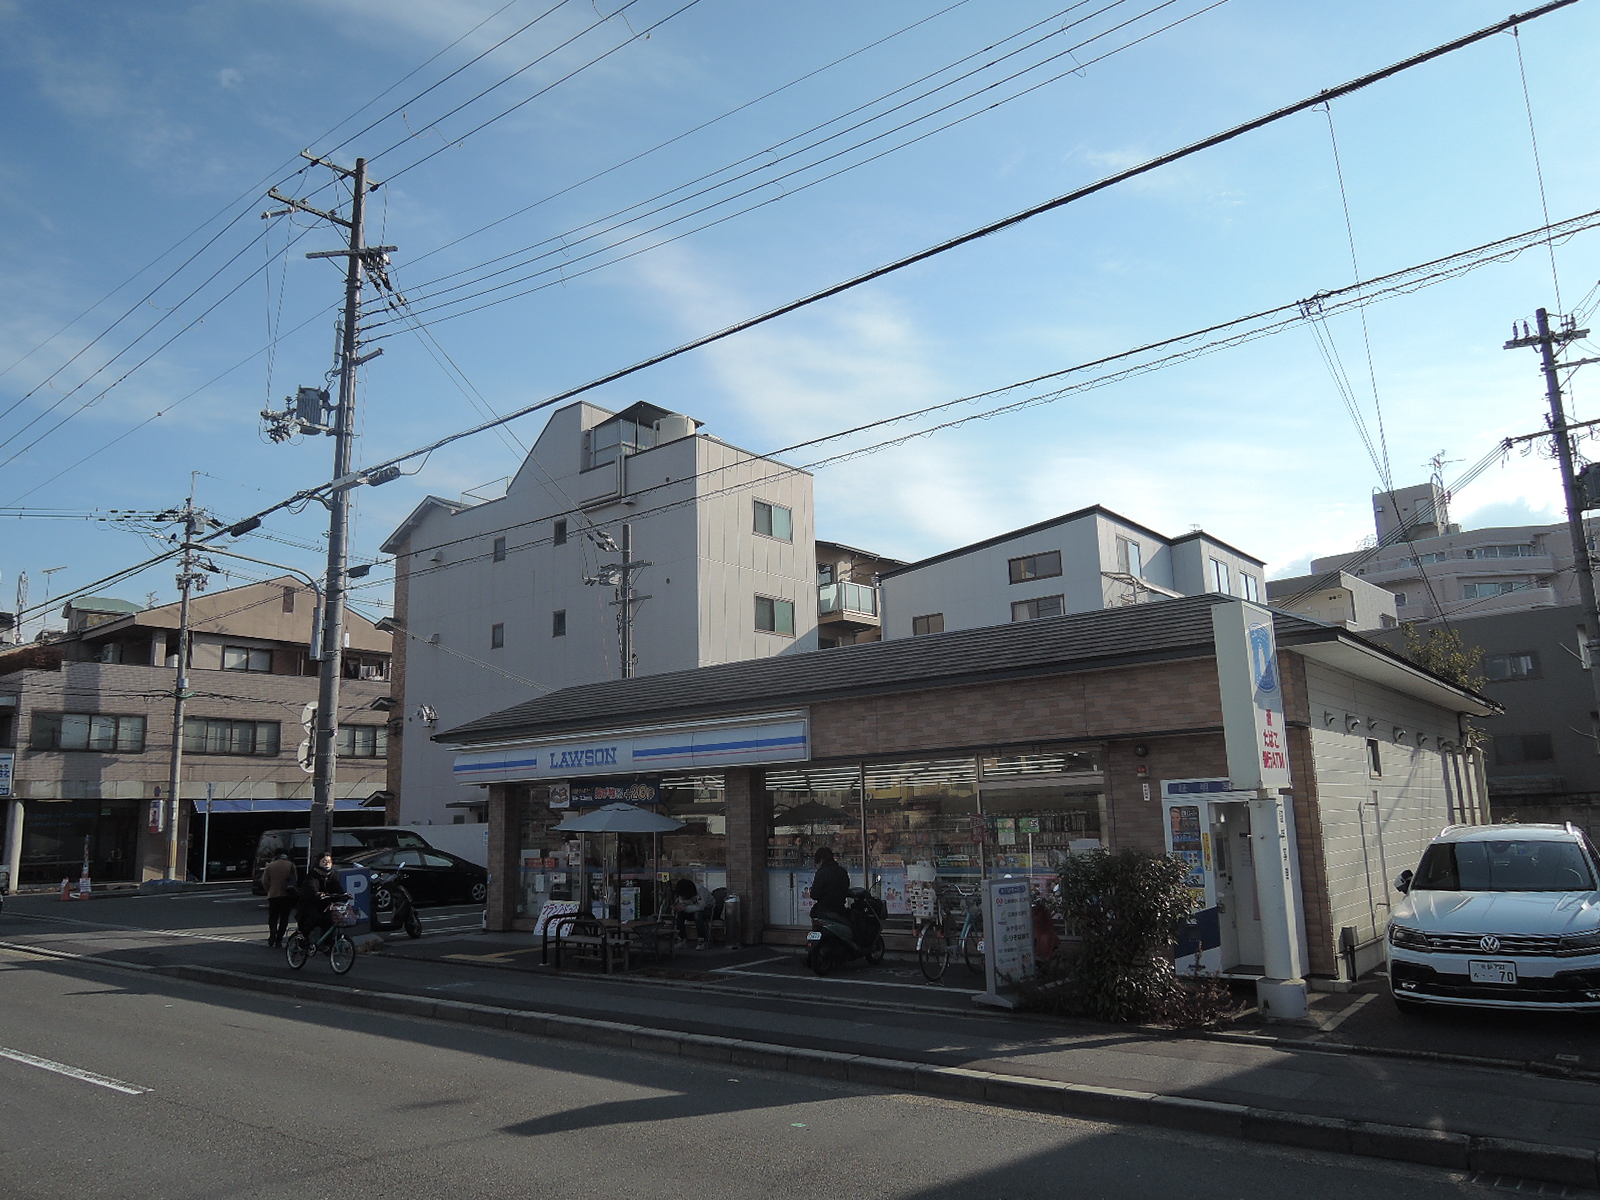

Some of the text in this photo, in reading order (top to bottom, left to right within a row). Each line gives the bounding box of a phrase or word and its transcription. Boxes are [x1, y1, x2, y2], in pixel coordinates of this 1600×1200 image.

[1263, 729, 1280, 748] たばこ
[549, 746, 618, 769] LAWSON
[1262, 751, 1286, 769] 銀行ATM
[345, 873, 369, 907] P
[1499, 971, 1514, 982] 70
